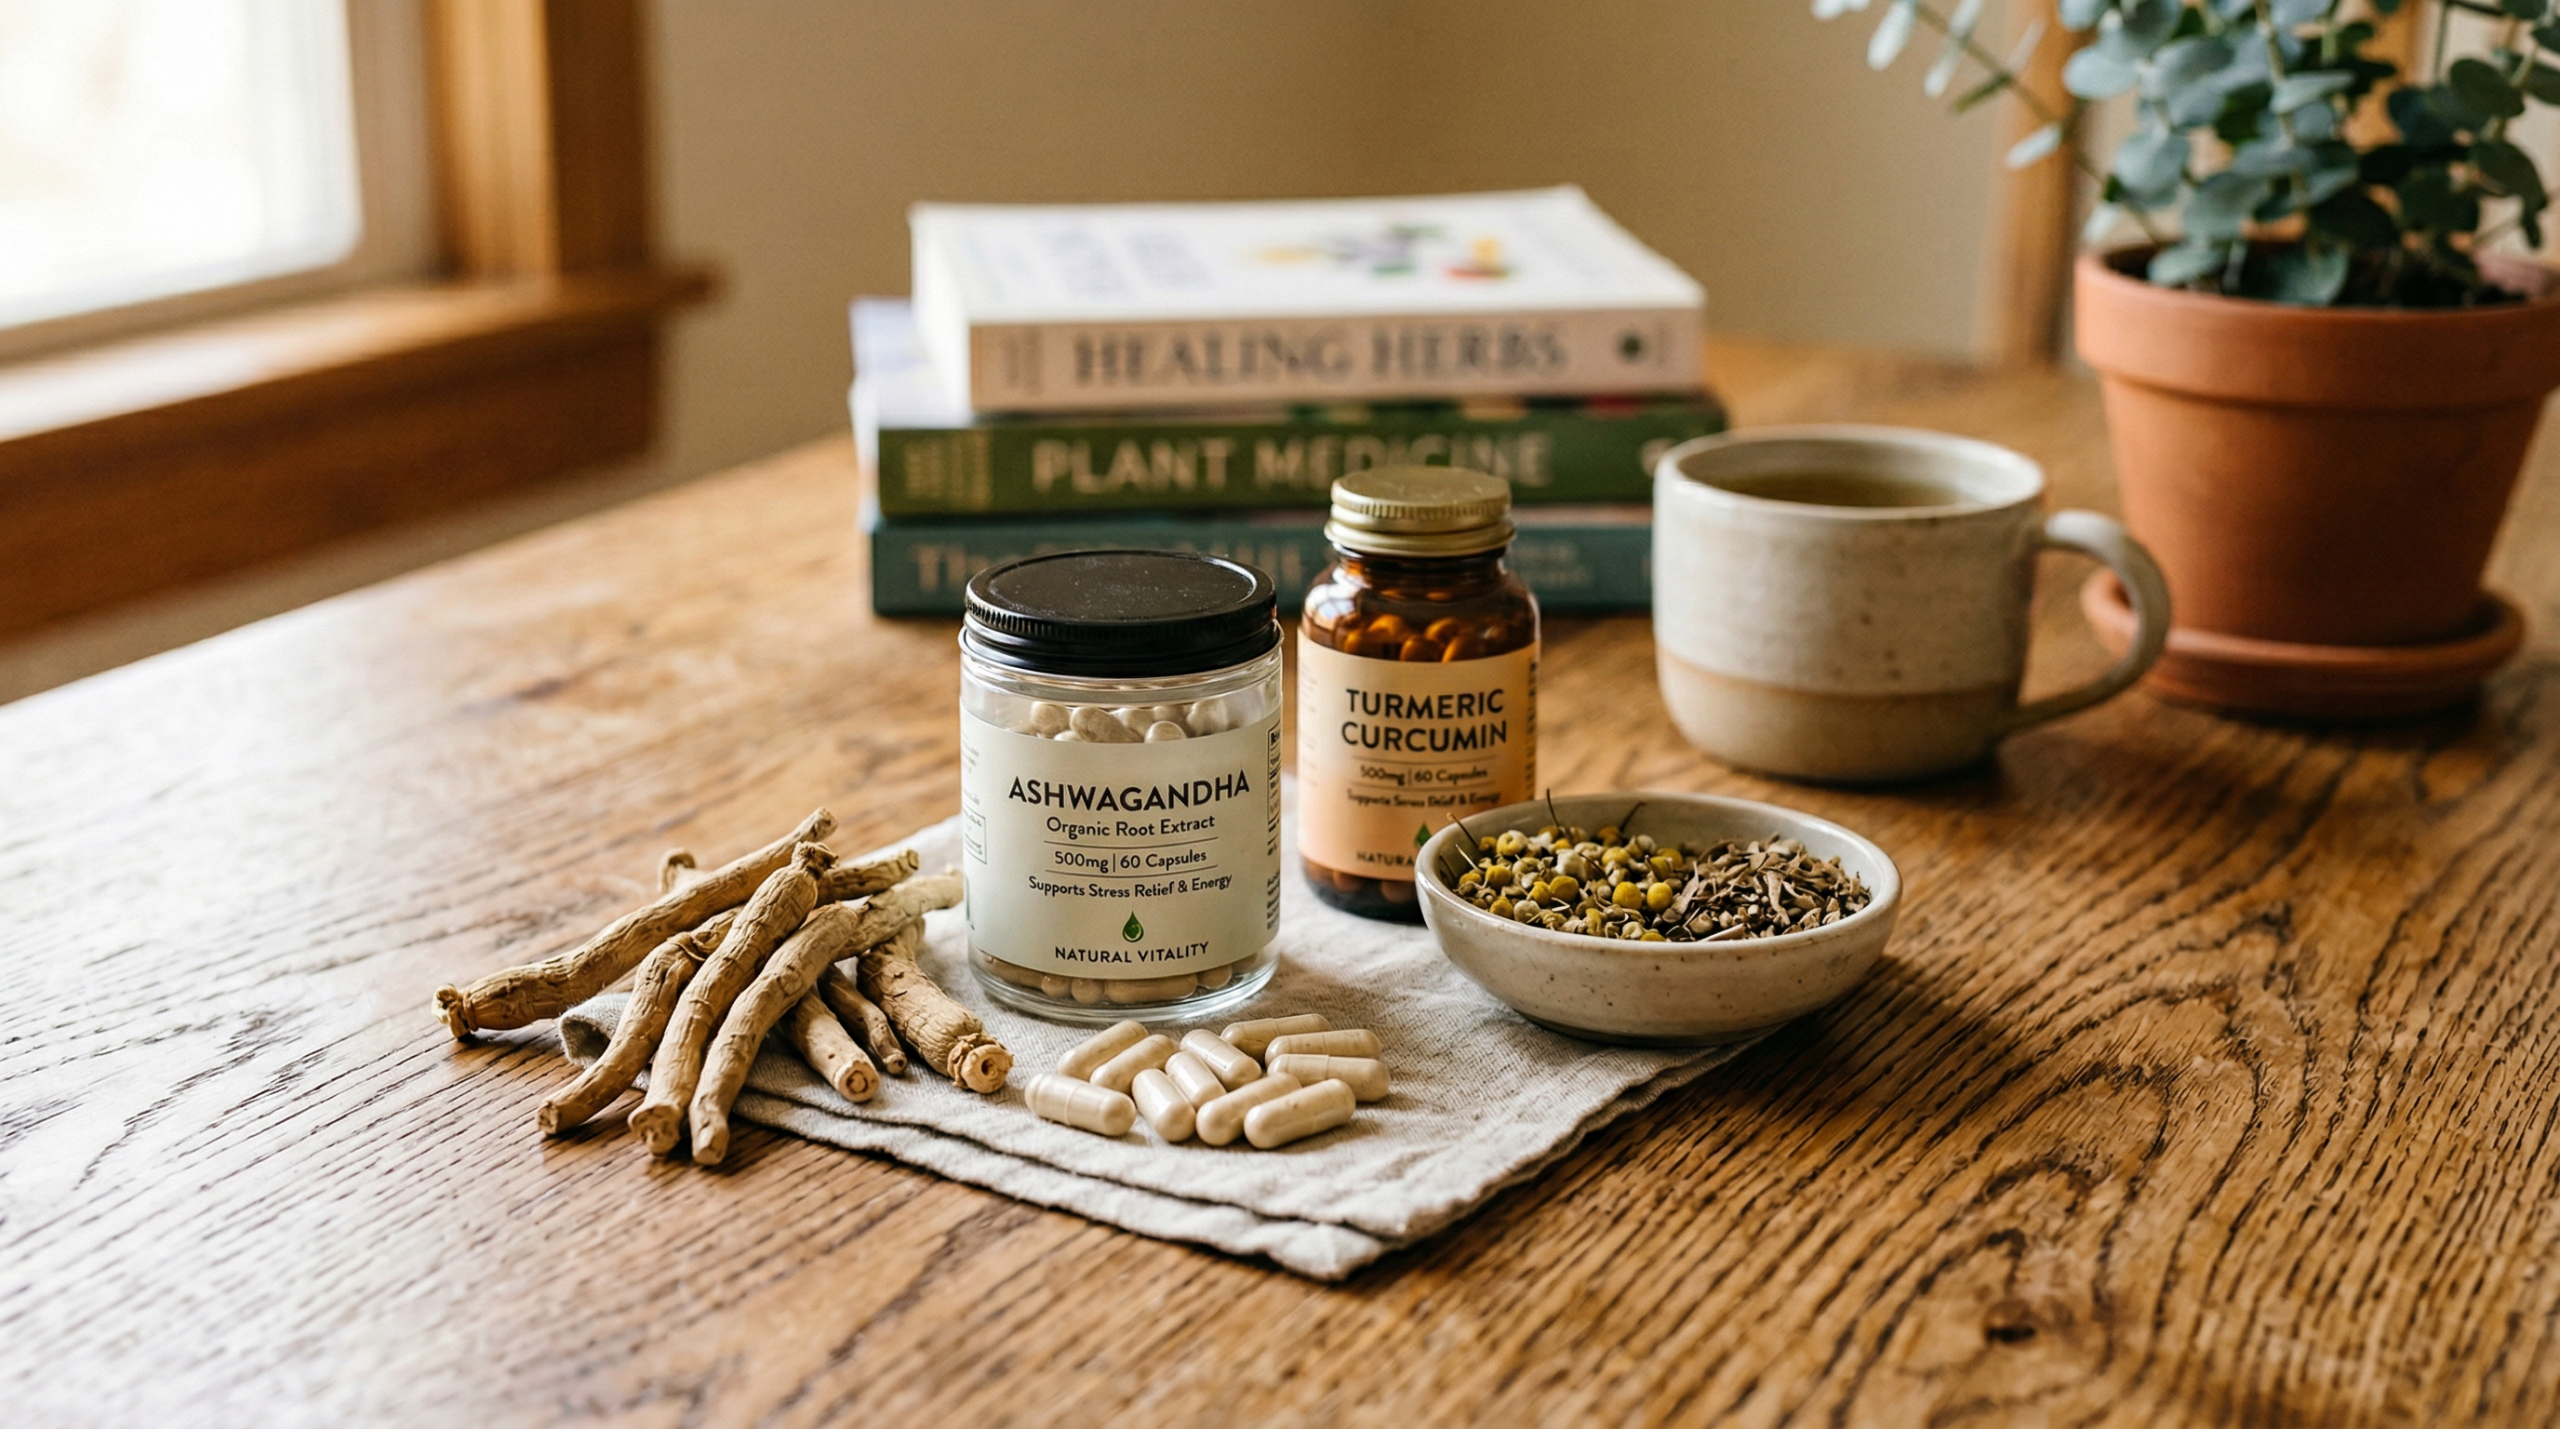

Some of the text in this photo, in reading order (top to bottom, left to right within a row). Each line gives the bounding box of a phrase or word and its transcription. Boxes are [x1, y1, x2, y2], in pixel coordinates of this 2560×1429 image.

[1073, 327, 1349, 388] HEALING
[1371, 321, 1568, 377] HERBS
[1031, 437, 1234, 494] PLANT
[1346, 688, 1504, 719] TURMERIC
[1342, 720, 1507, 752] CURCUMIN
[1360, 765, 1405, 786] 500mg
[1414, 769, 1433, 783] 60
[1008, 769, 1250, 811] ASHWAGANDHA
[1046, 815, 1215, 840] Organic Root Extract
[1055, 851, 1109, 873] 500mg
[1120, 855, 1141, 869] 60
[1145, 849, 1207, 871] Capsules
[1356, 851, 1416, 867] NATURA
[1028, 876, 1085, 897] Supports
[1089, 883, 1130, 898] Stress
[1178, 880, 1188, 893] &
[1192, 875, 1232, 891] Energy
[1055, 941, 1209, 963] NATURAL VITALITY
